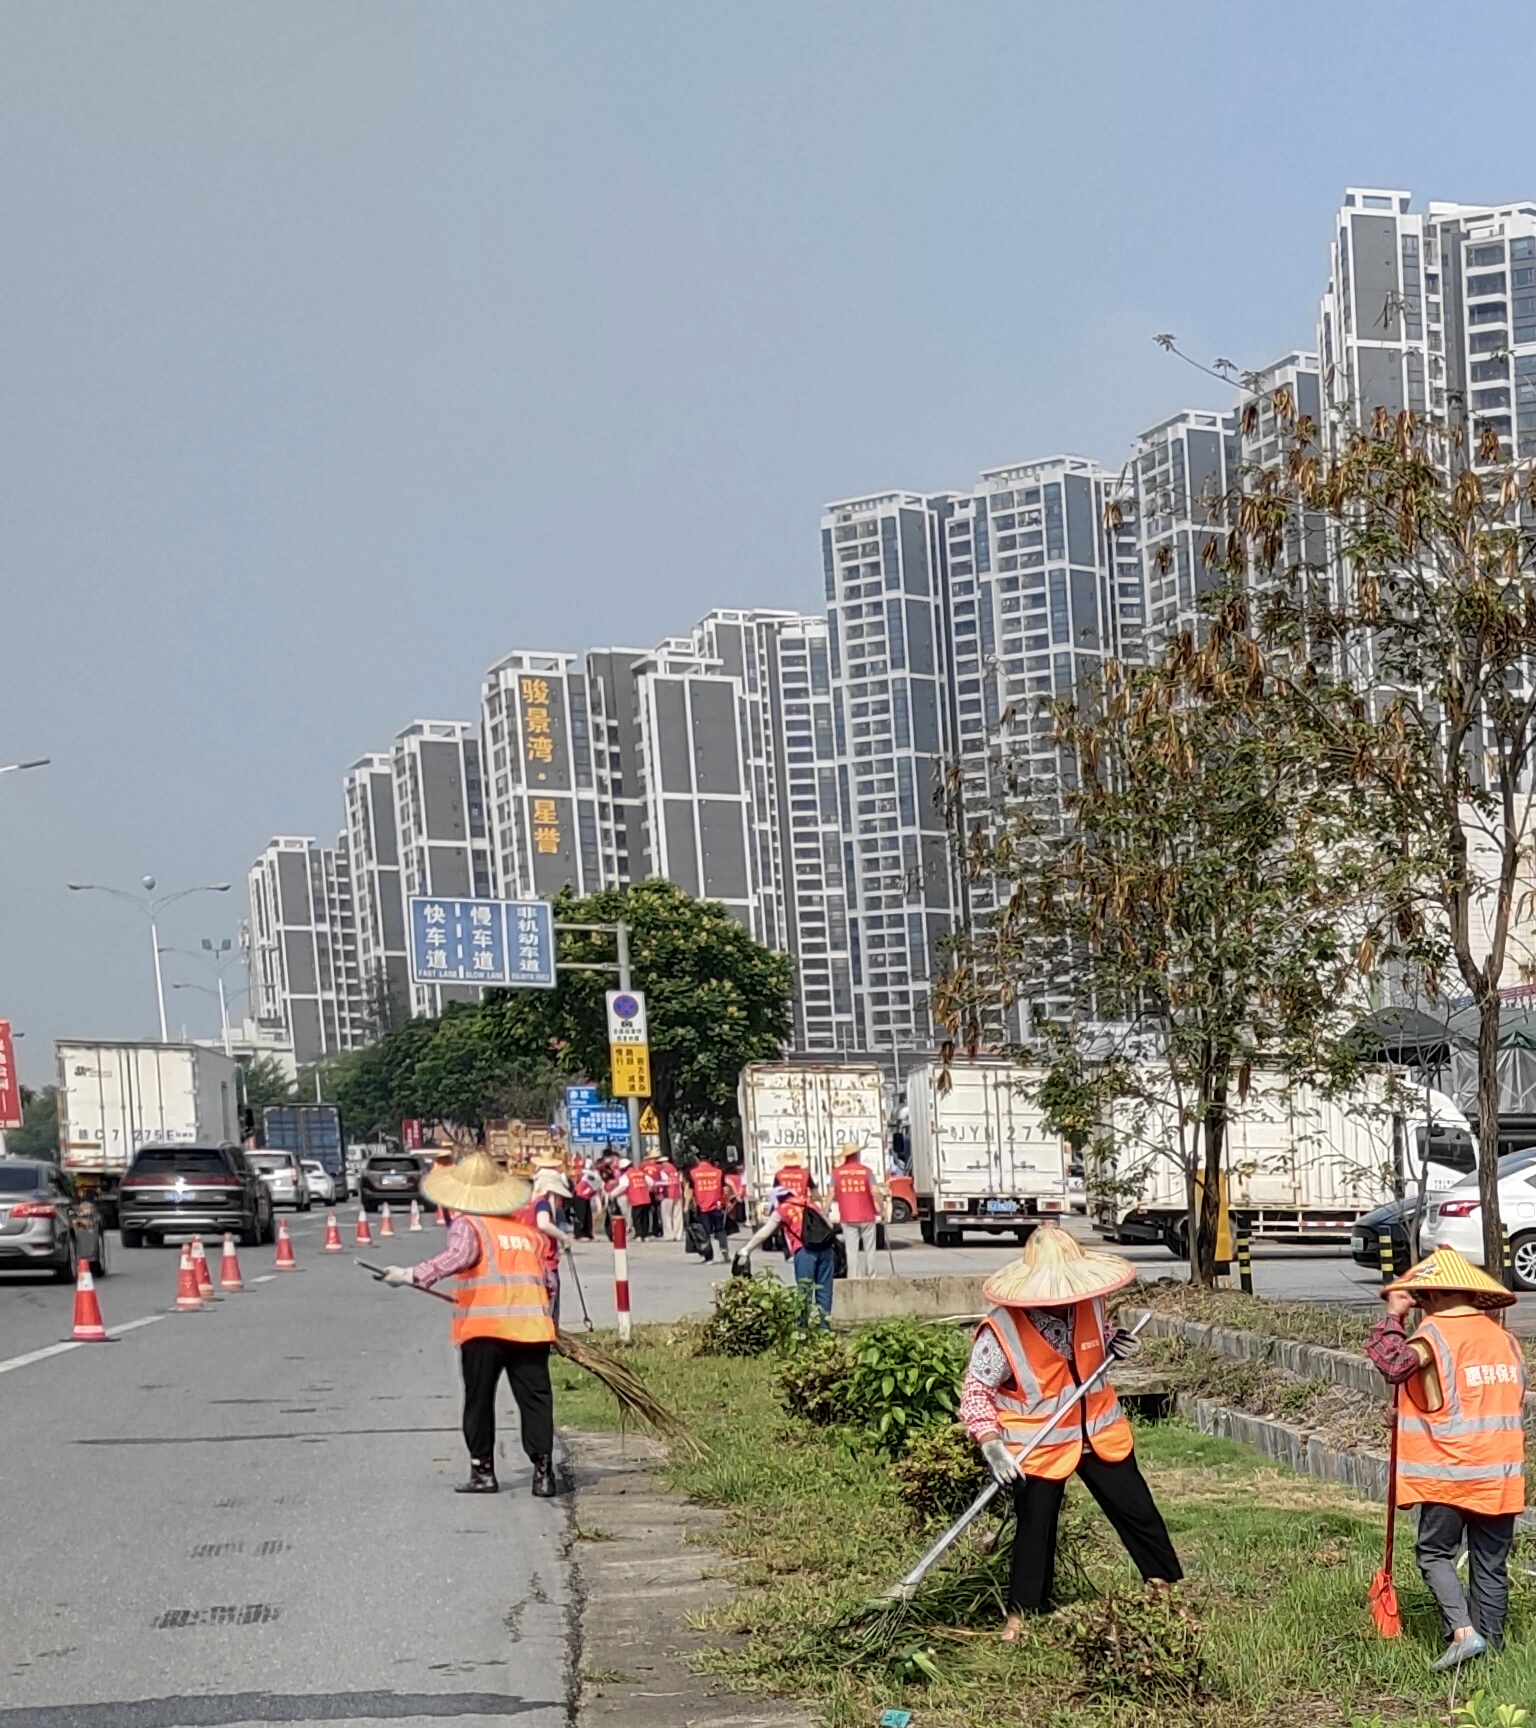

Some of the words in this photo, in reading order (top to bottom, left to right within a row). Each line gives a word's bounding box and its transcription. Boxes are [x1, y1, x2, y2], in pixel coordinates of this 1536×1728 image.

[423, 903, 448, 970] 快车道
[470, 905, 495, 971] 慢车道
[516, 906, 541, 973] 非机动车道
